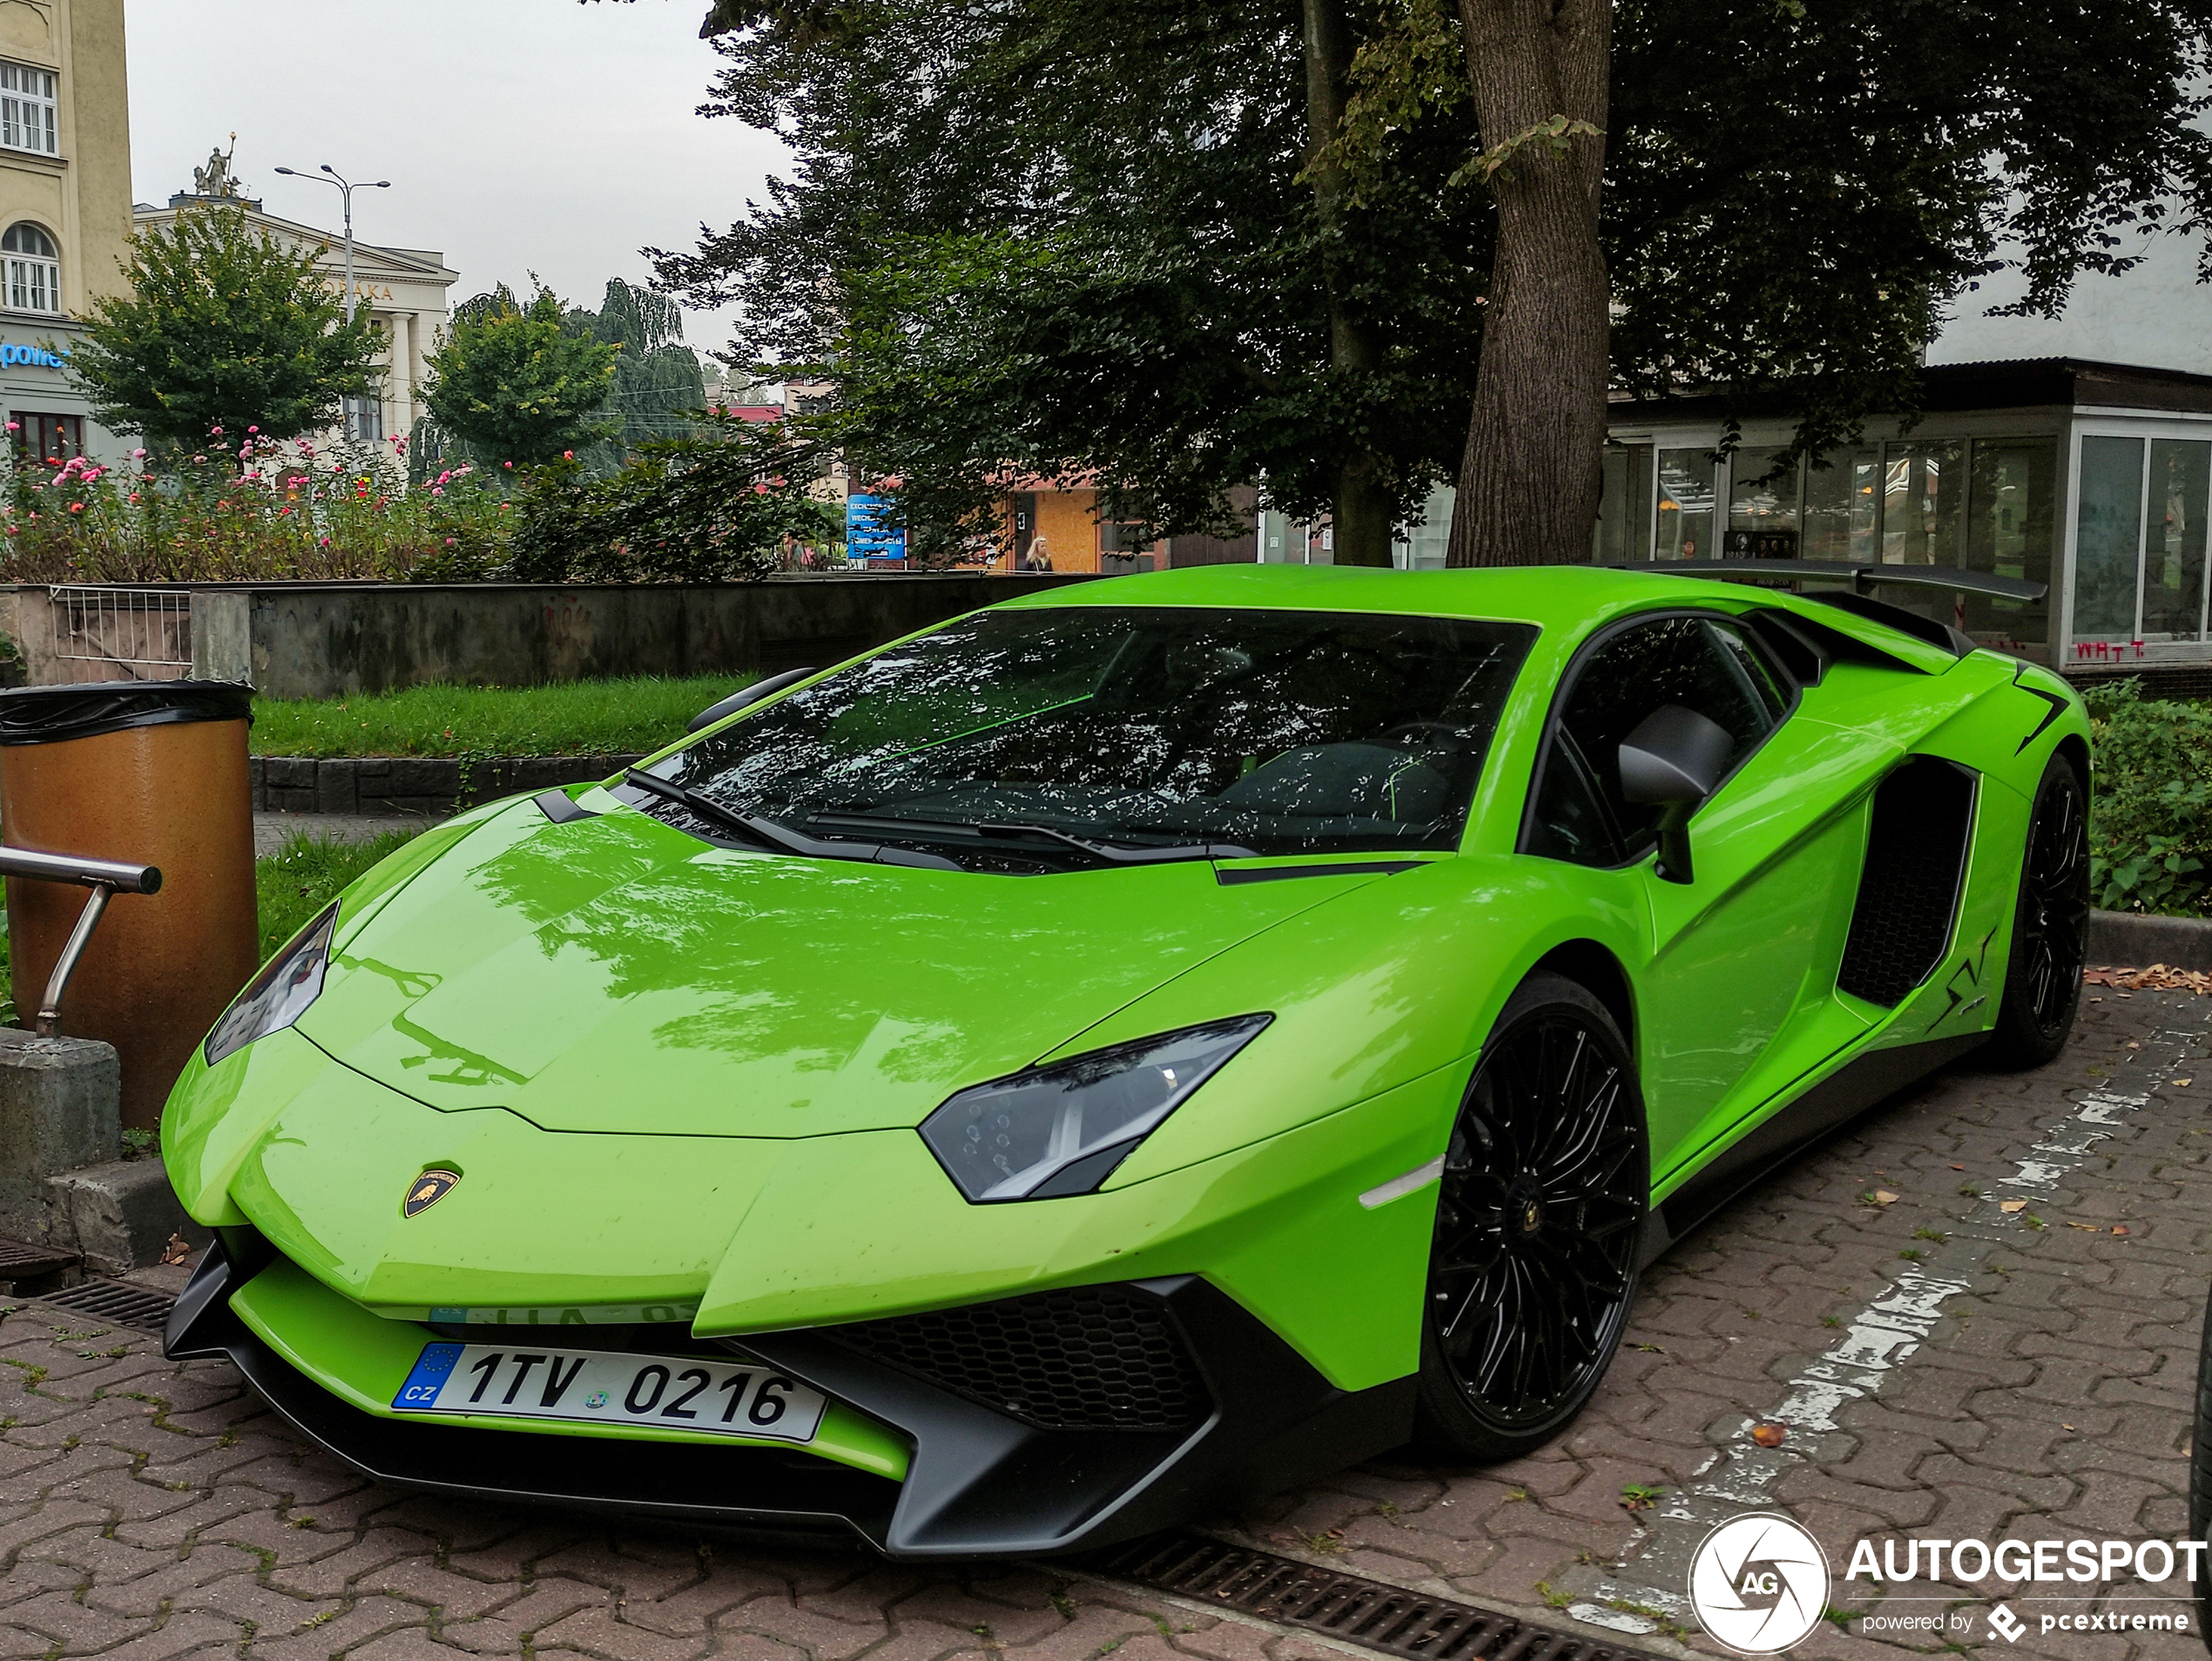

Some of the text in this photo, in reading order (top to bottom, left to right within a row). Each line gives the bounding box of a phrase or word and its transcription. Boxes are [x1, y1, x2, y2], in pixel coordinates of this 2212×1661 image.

[405, 1386, 437, 1401] CZ
[469, 1353, 793, 1427] 1TV 0216
